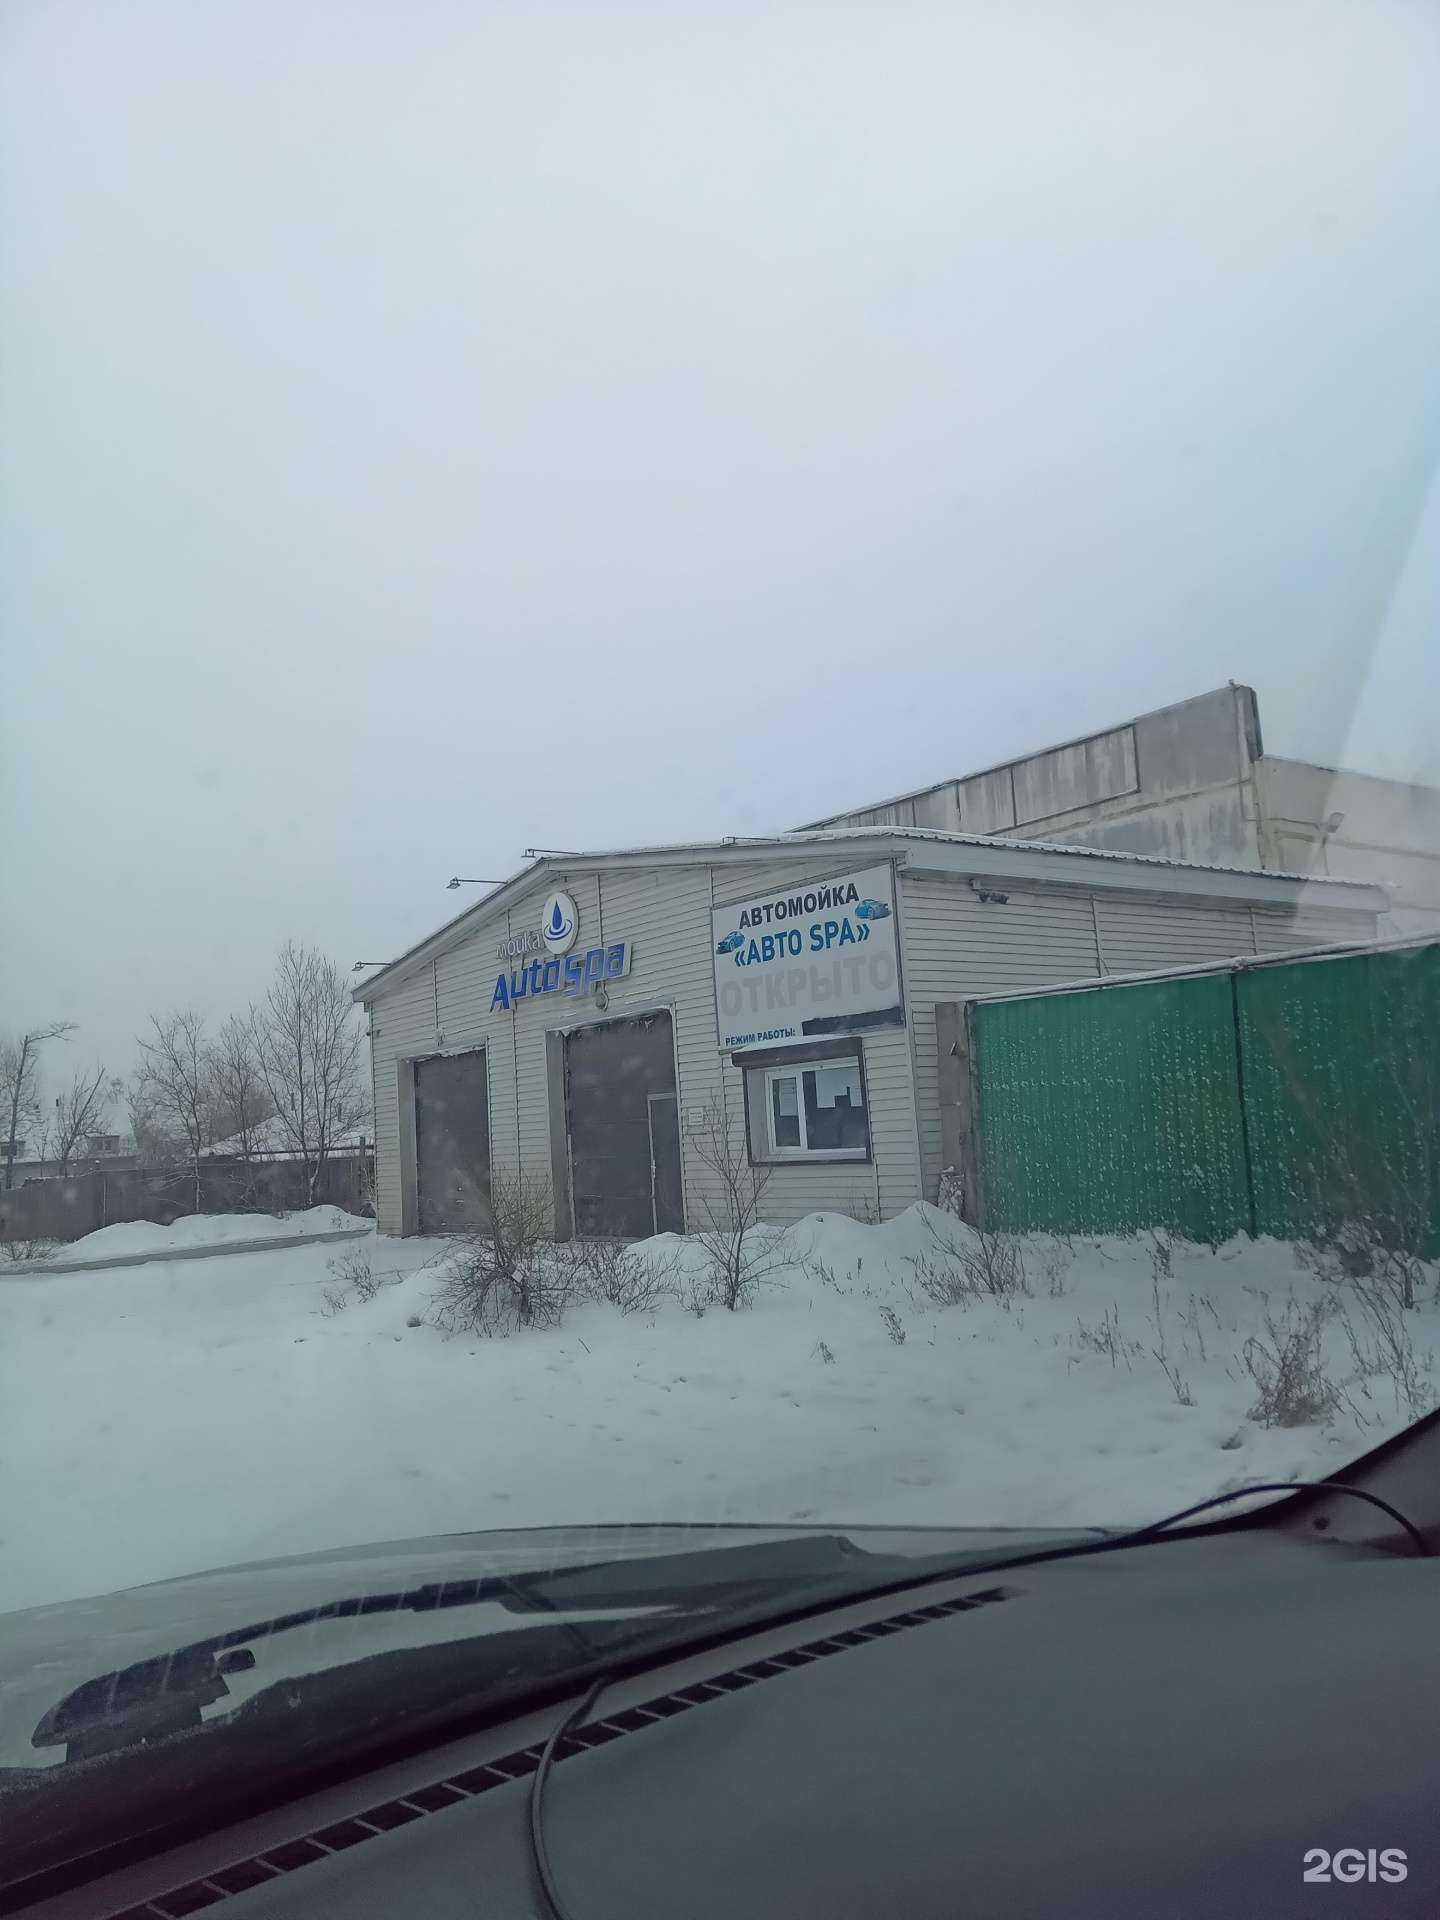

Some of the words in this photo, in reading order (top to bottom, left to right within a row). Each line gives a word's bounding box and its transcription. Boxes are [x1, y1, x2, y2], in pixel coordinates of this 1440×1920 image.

[739, 883, 859, 929] АВТОМОЙКА
[734, 930, 802, 967] «АВТО
[810, 918, 870, 951] SPA»
[720, 953, 895, 1017] ОТКРЫТО
[725, 1033, 756, 1046] РЕЖИМ
[757, 1028, 796, 1042] РАБОТЫ:
